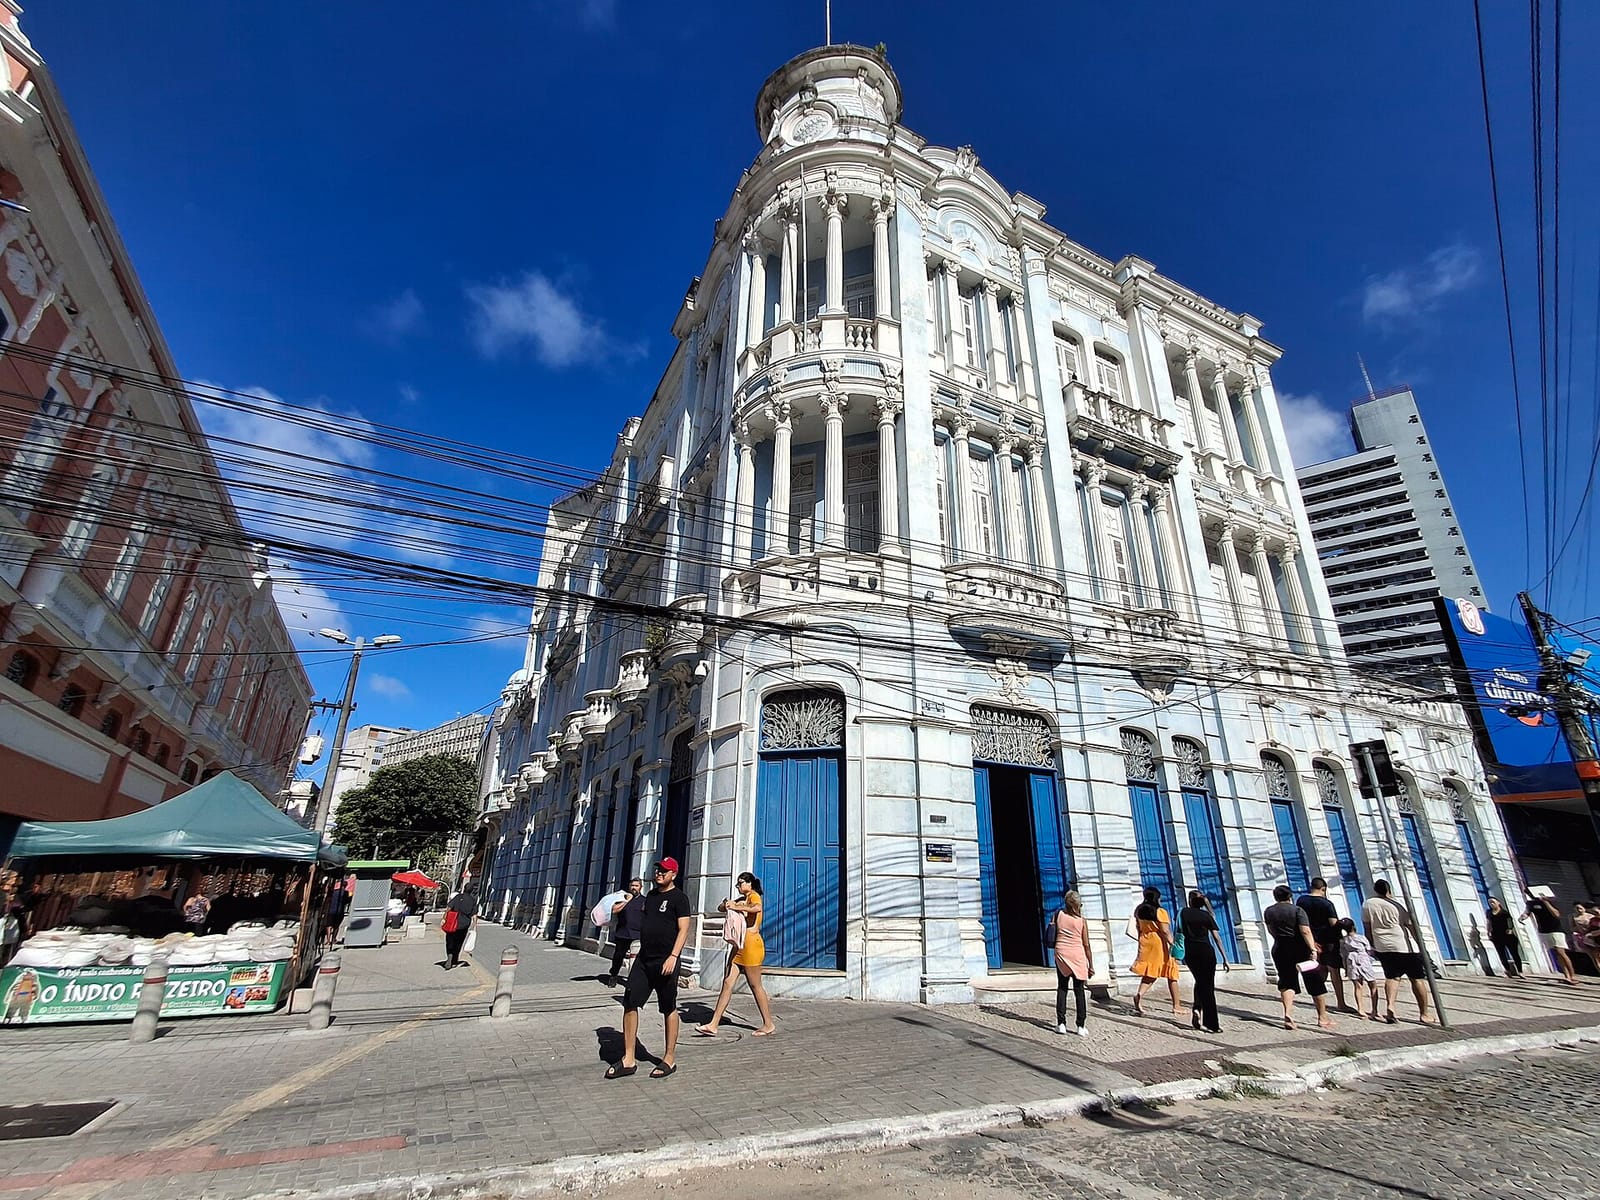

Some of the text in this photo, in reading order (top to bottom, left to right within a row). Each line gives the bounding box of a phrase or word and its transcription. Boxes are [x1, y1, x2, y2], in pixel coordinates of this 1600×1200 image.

[98, 968, 132, 976] conhecido
[41, 979, 227, 1003] O ÍNDIO RZEIRO
